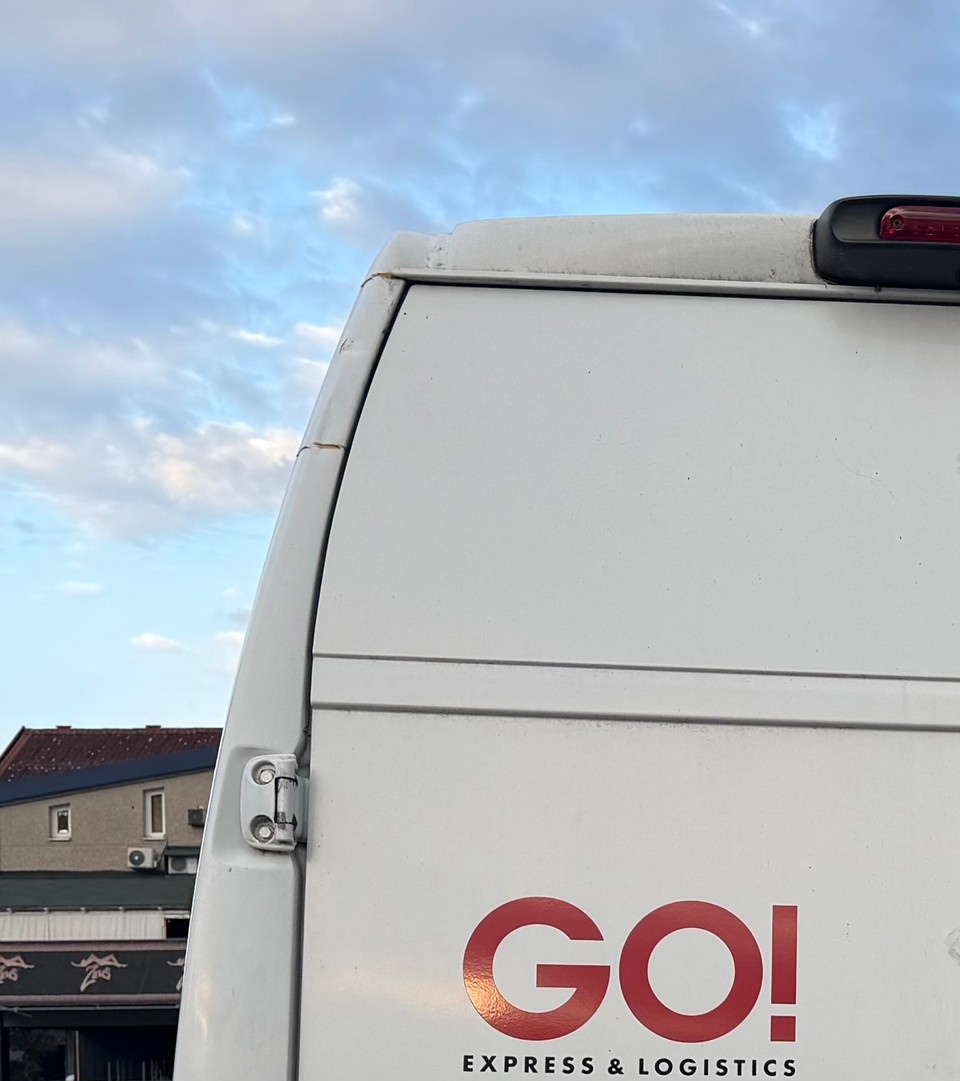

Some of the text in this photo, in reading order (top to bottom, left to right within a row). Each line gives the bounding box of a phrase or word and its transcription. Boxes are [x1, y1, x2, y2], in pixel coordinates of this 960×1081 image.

[463, 896, 798, 1043] GO!
[463, 1055, 797, 1077] EXPRESS & LOGISTICS
